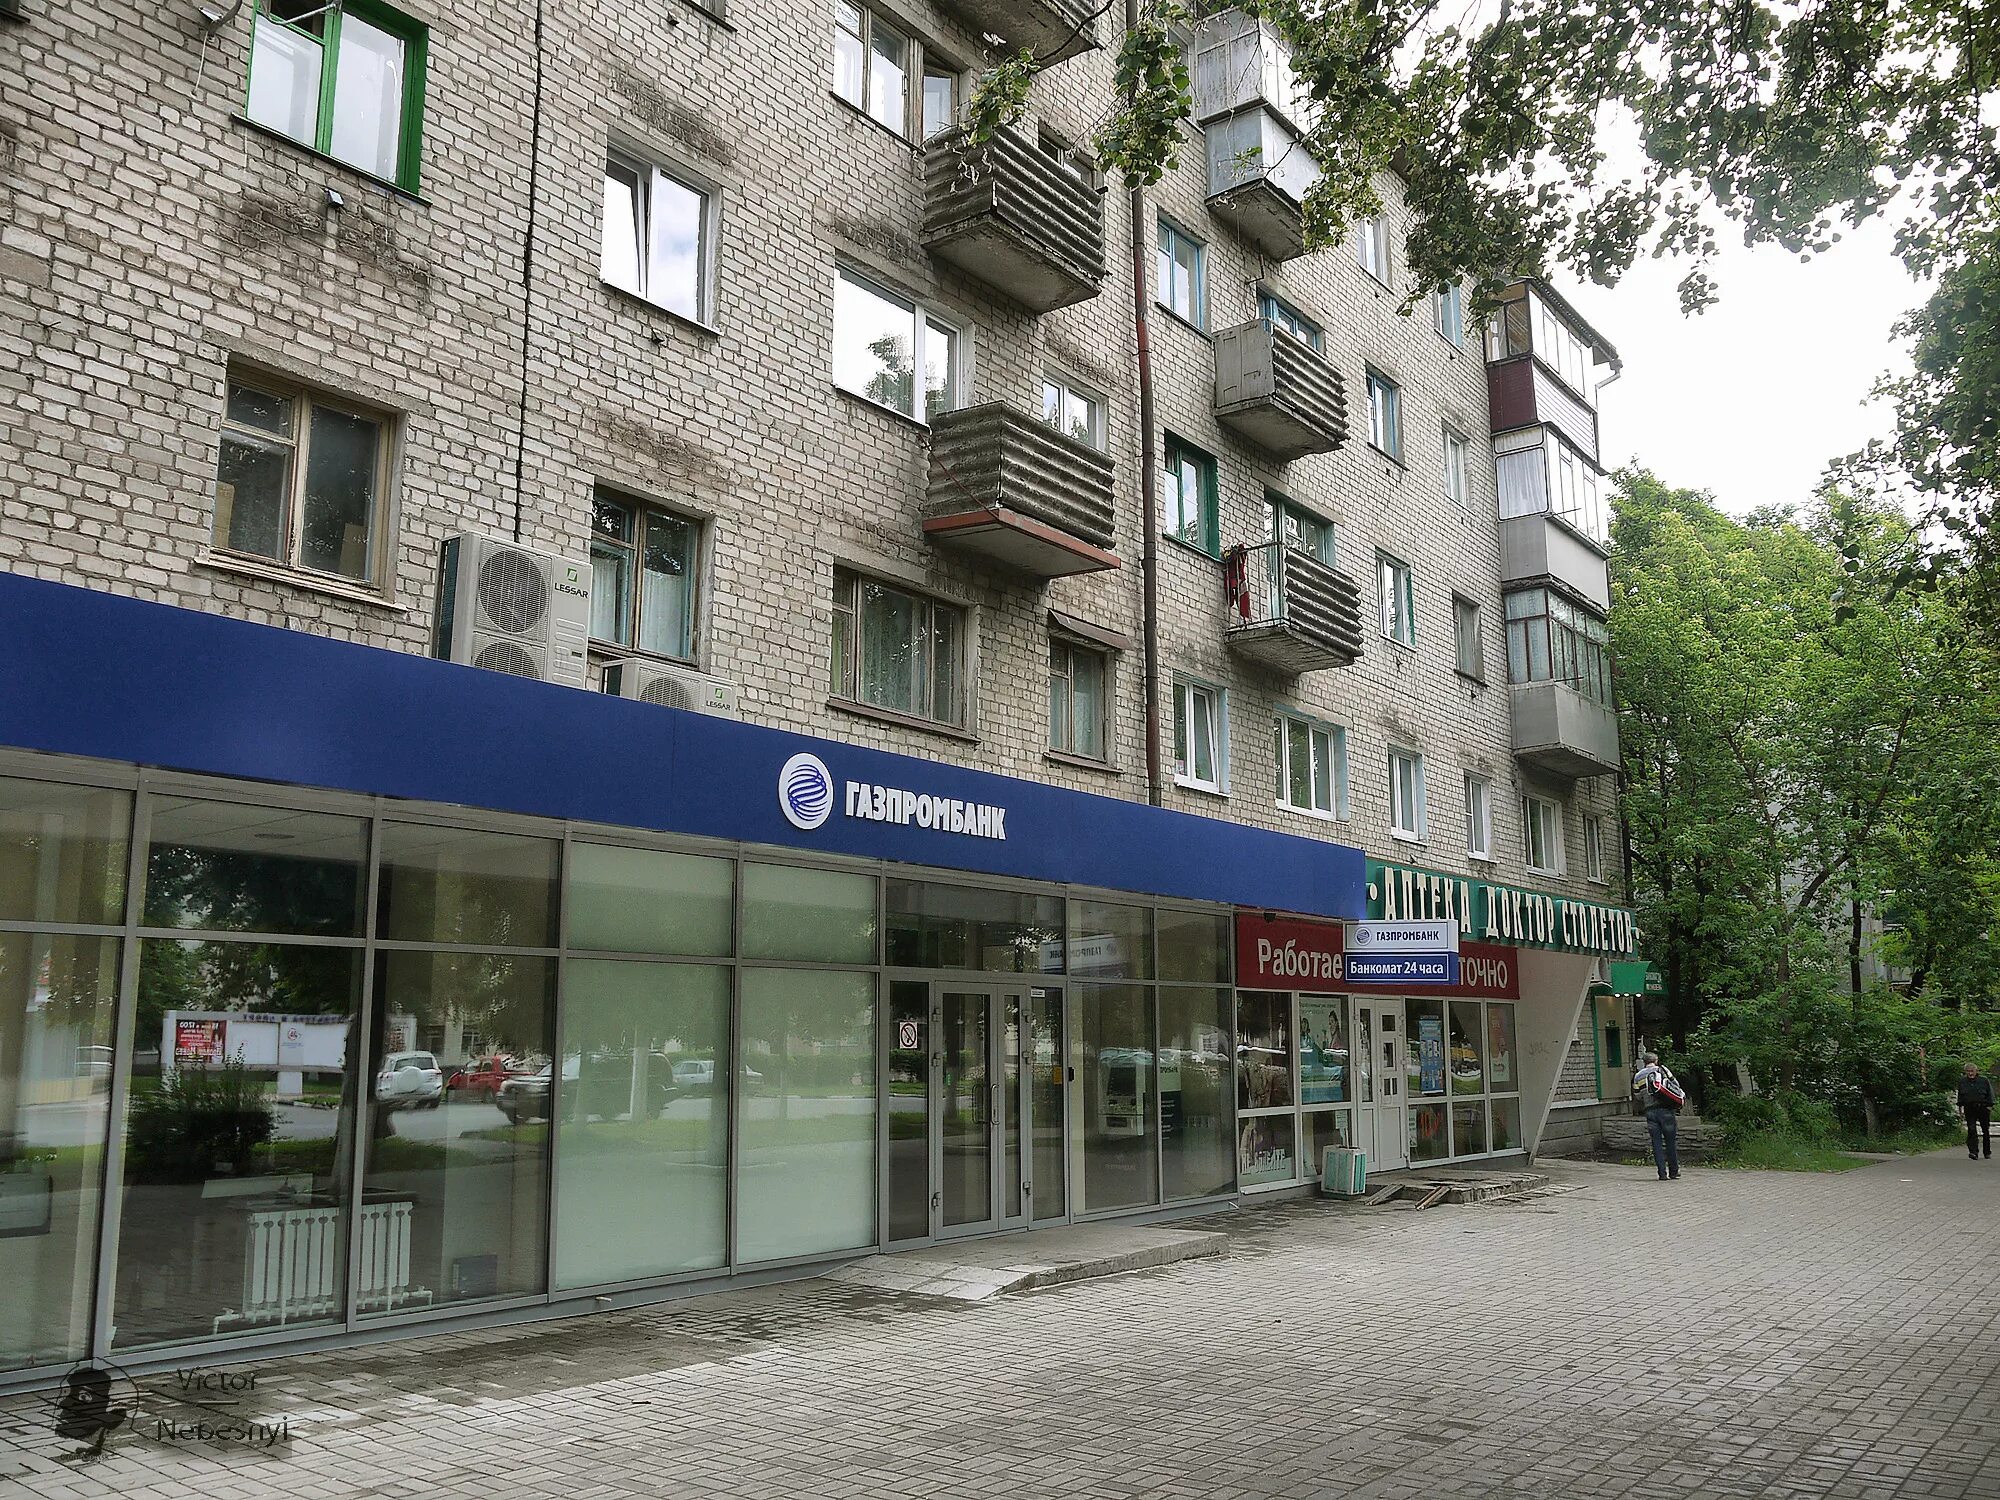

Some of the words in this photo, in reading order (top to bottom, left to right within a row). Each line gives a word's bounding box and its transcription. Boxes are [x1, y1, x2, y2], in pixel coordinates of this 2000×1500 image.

[554, 582, 589, 599] LESSAR
[706, 700, 731, 711] LESSAR
[845, 780, 1007, 840] ГАЗПРОМБАНК
[1384, 866, 1472, 934] АПТЕКА
[1485, 886, 1555, 944] ДОКТОР
[1561, 900, 1633, 953] СТОЛЕТОВ
[1376, 930, 1440, 941] ГАЗПРОМБАНК
[1350, 961, 1403, 974] Банкомат
[1403, 961, 1417, 974] 24
[1419, 964, 1444, 974] часа
